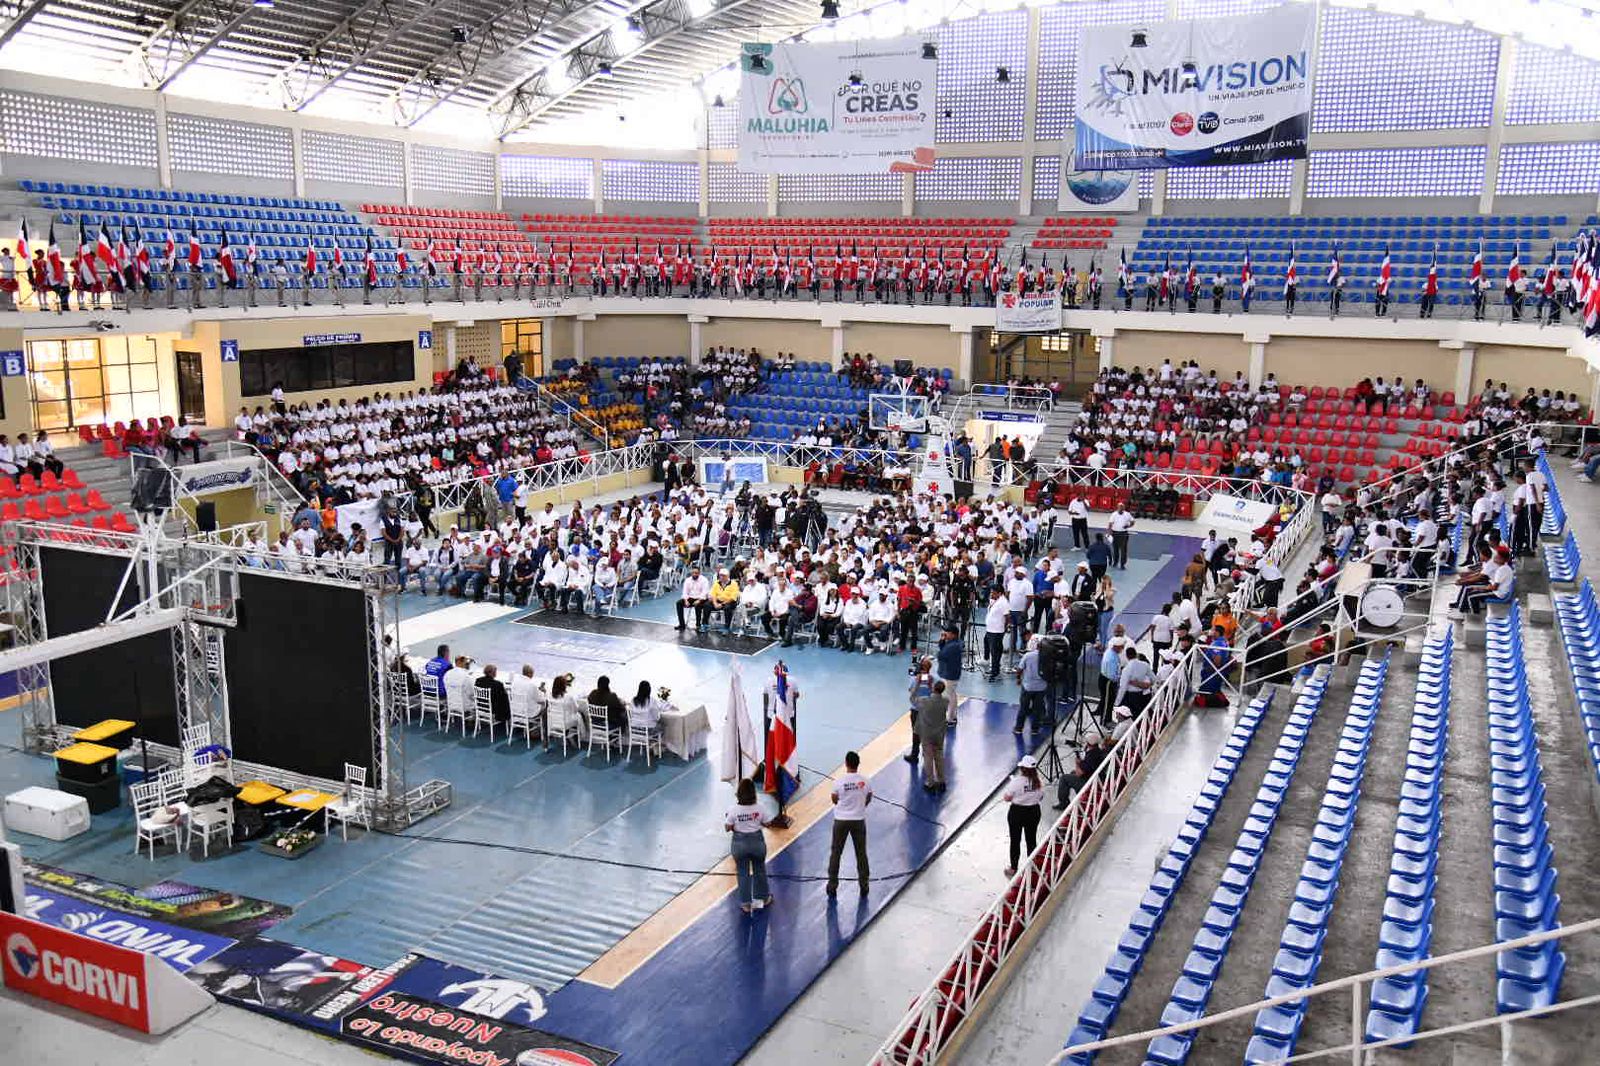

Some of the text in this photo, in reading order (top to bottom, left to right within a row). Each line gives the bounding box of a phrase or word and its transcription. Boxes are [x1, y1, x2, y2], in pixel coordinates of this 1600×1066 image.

[903, 80, 922, 92] NO
[846, 93, 919, 113] CREAS
[747, 118, 829, 133] MALUHIA
[421, 336, 430, 348] A
[224, 347, 236, 360] A
[6, 359, 21, 375] B
[87, 920, 206, 967] WIND
[42, 950, 140, 1011] CORVI
[368, 996, 503, 1043] Nuestro
[350, 1018, 511, 1066] Apoyando Lo
